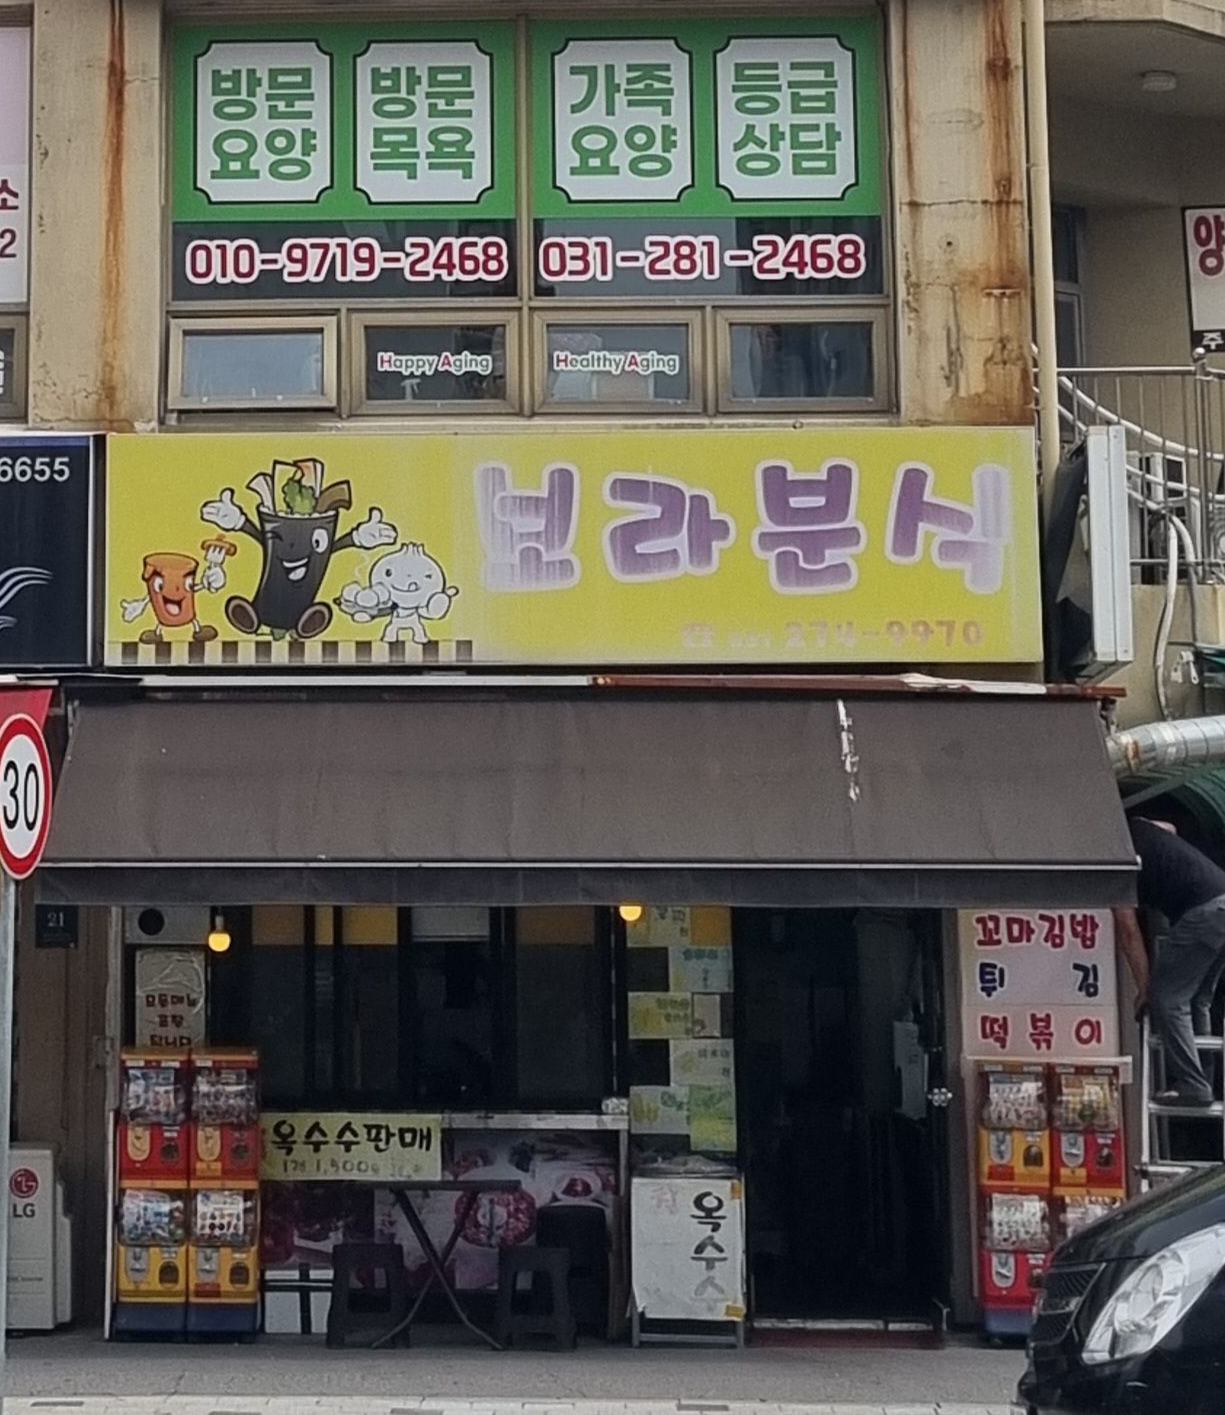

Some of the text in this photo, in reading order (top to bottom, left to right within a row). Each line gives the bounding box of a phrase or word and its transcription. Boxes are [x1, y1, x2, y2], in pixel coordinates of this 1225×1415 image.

[210, 66, 315, 121] 방문
[370, 64, 473, 120] 방문
[569, 62, 675, 117] 가족
[732, 60, 837, 116] 등급
[210, 127, 317, 182] 요양
[370, 126, 474, 180] 목욕
[569, 124, 677, 179] 요양
[732, 121, 842, 177] 상담
[187, 239, 508, 282] 010-9719-2468
[540, 235, 866, 280] 031-281-2468
[378, 352, 492, 375] Happy Aging
[555, 352, 679, 375] Healthy Aging
[474, 459, 1013, 596] 보라분식
[2, 760, 39, 832] 30
[975, 914, 1099, 949] 꼬마김밥
[271, 1120, 432, 1154] 옥수수판매
[12, 1203, 36, 1218] LG
